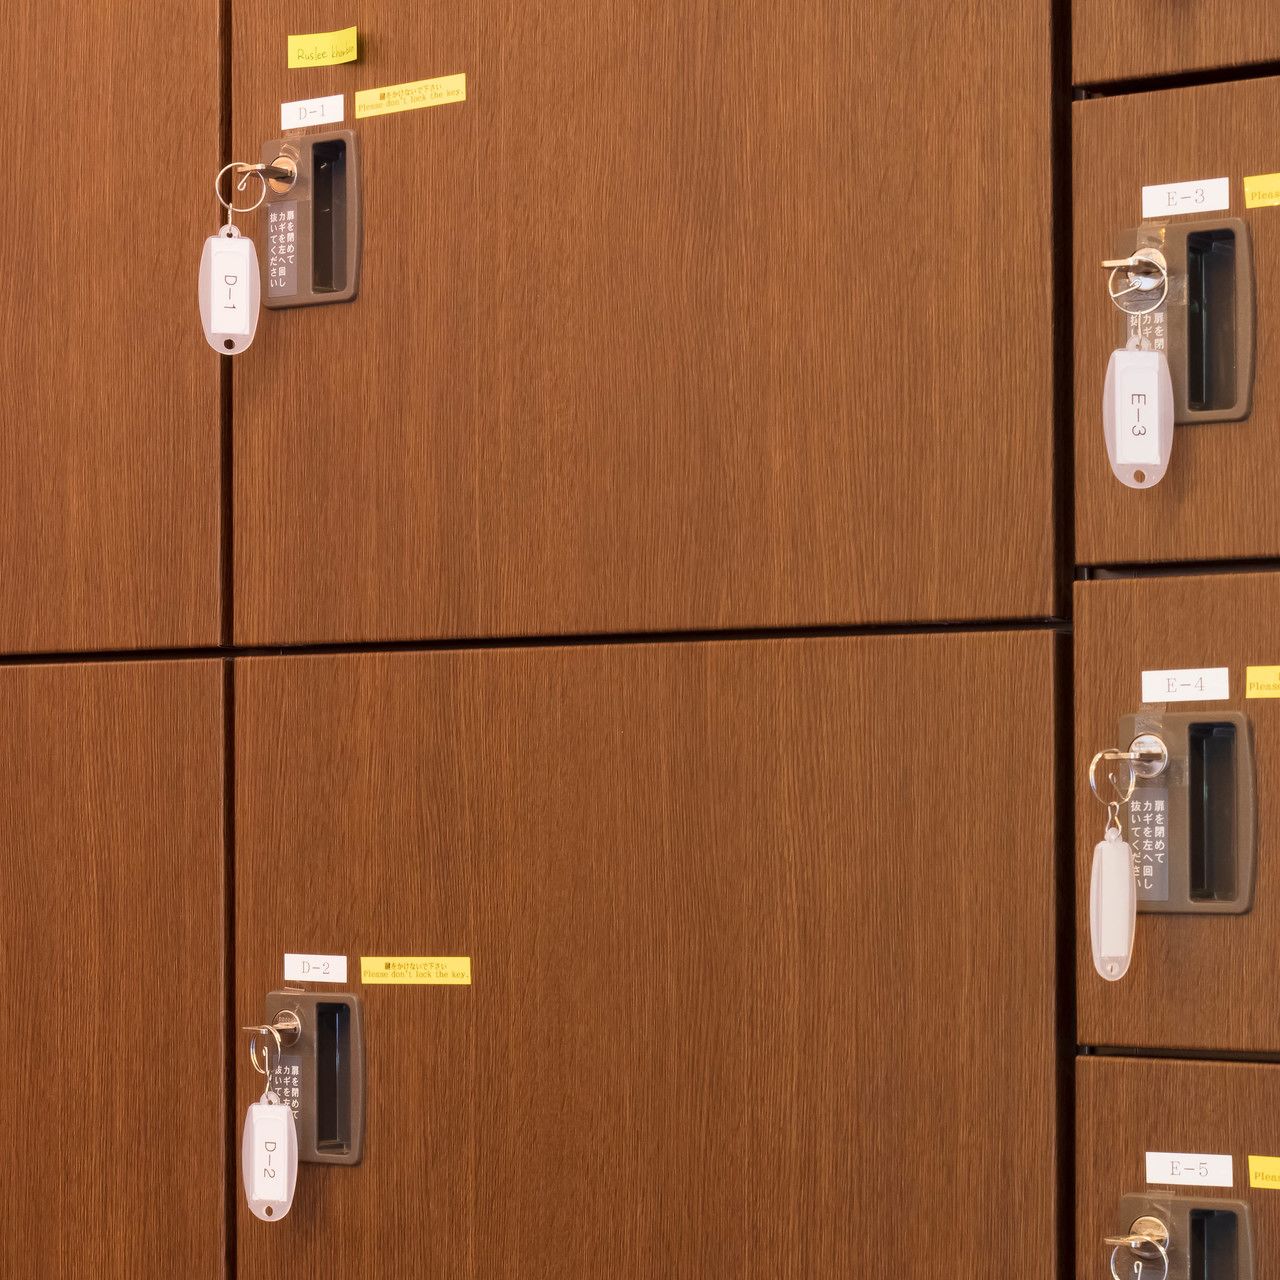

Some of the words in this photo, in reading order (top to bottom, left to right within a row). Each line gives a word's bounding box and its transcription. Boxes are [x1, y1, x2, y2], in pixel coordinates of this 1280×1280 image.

[432, 90, 446, 100] the
[299, 104, 325, 120] D-1
[1167, 188, 1205, 207] E-3
[224, 275, 237, 309] D-1
[1131, 393, 1146, 436] E-3
[1166, 676, 1207, 693] E-4
[1154, 800, 1165, 864] 扉を閉めて
[1142, 800, 1153, 889] カギを左へ回し
[302, 961, 330, 975] D-2
[263, 1141, 276, 1179] D-2
[1170, 1161, 1209, 1177] E-5
